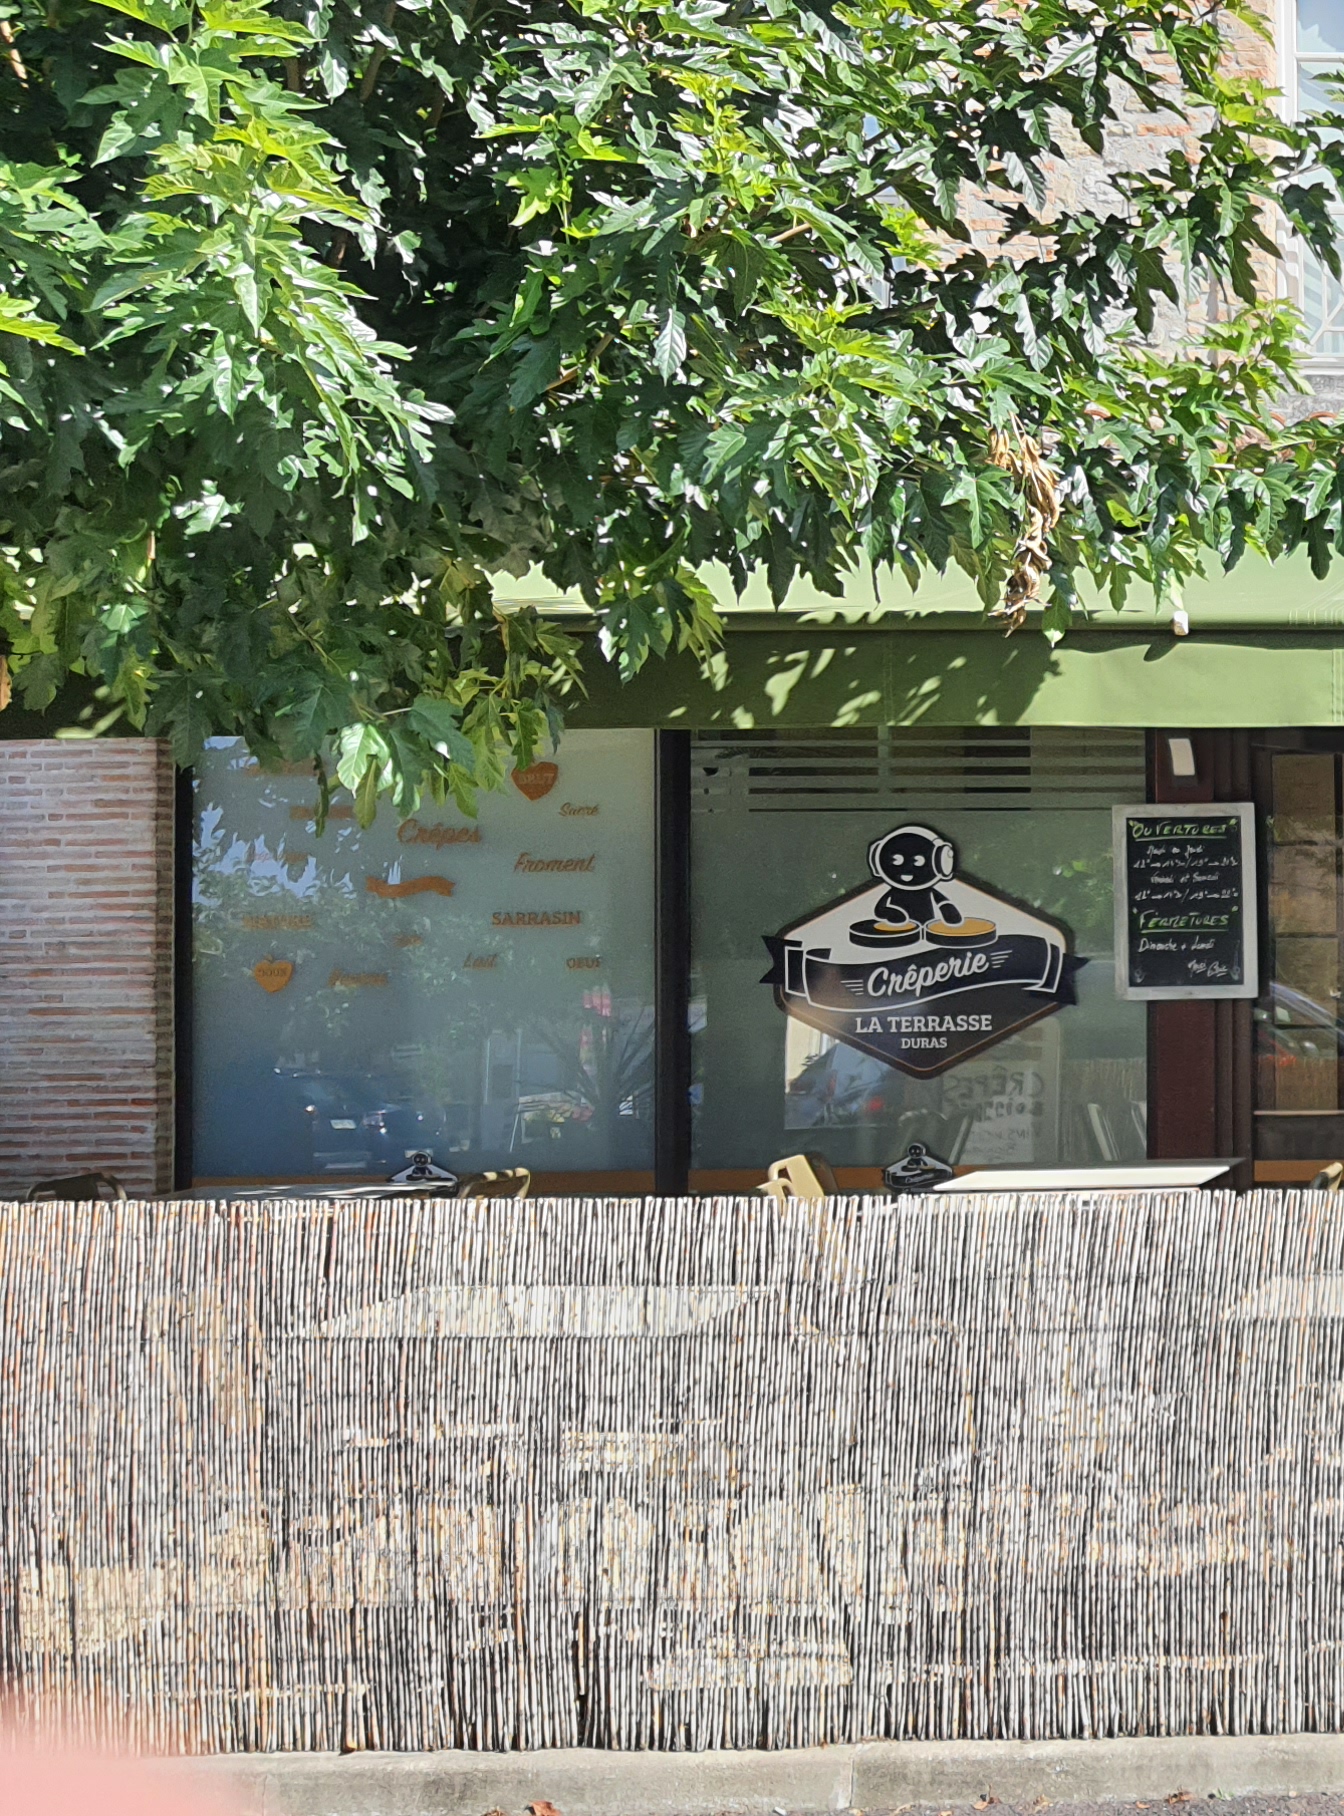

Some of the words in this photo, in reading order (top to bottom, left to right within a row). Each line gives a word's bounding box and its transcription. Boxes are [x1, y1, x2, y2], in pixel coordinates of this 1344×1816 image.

[514, 851, 596, 874] Froment
[491, 910, 582, 928] SARRASIN
[867, 950, 990, 998] Crêperie
[855, 1016, 884, 1034] LA
[886, 1014, 993, 1033] TERRASSE
[900, 1036, 948, 1050] DURAS
